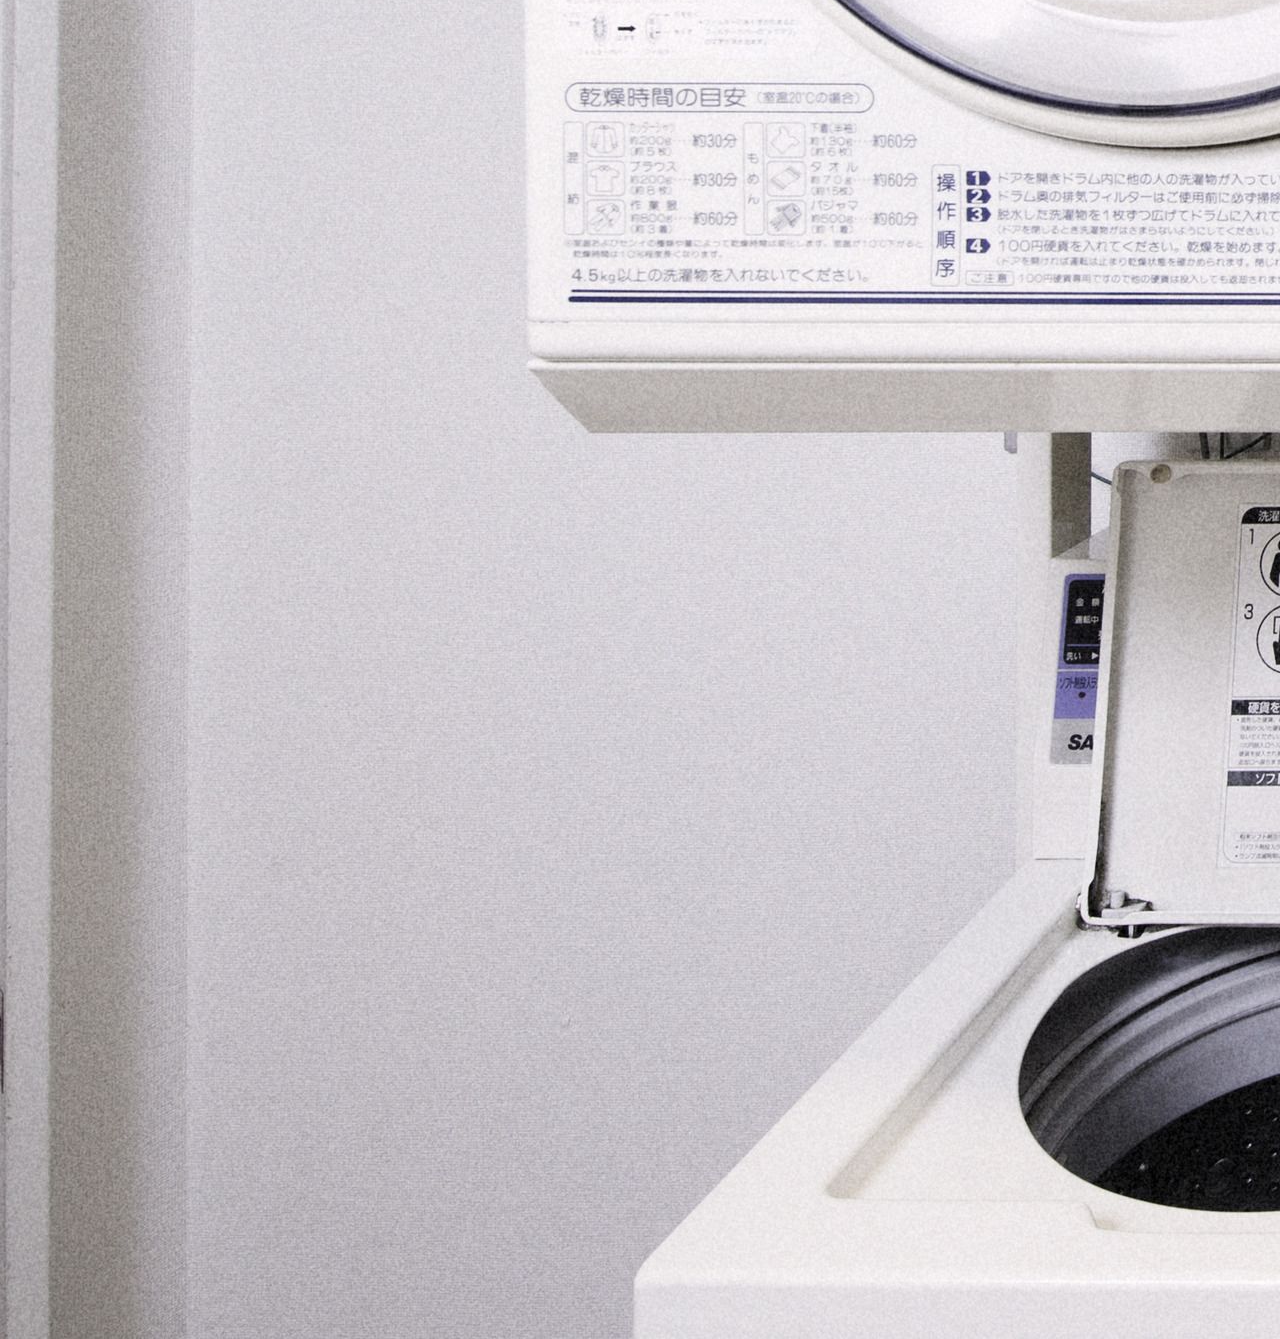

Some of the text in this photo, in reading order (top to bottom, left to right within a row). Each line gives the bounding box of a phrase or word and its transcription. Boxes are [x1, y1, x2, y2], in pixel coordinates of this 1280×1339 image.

[579, 87, 748, 109] 乾燥時間の目安
[692, 133, 737, 148] 約30分
[872, 133, 917, 149] 約60分
[693, 172, 738, 188] 約30分
[872, 172, 918, 188] 約60分
[971, 171, 981, 185] 1
[971, 190, 983, 203] 2
[693, 211, 738, 227] 約60分
[873, 211, 919, 227] 約60分
[970, 208, 982, 222] 3
[935, 172, 957, 279] 操作順序
[970, 239, 983, 253] 4
[1243, 603, 1254, 620] 3
